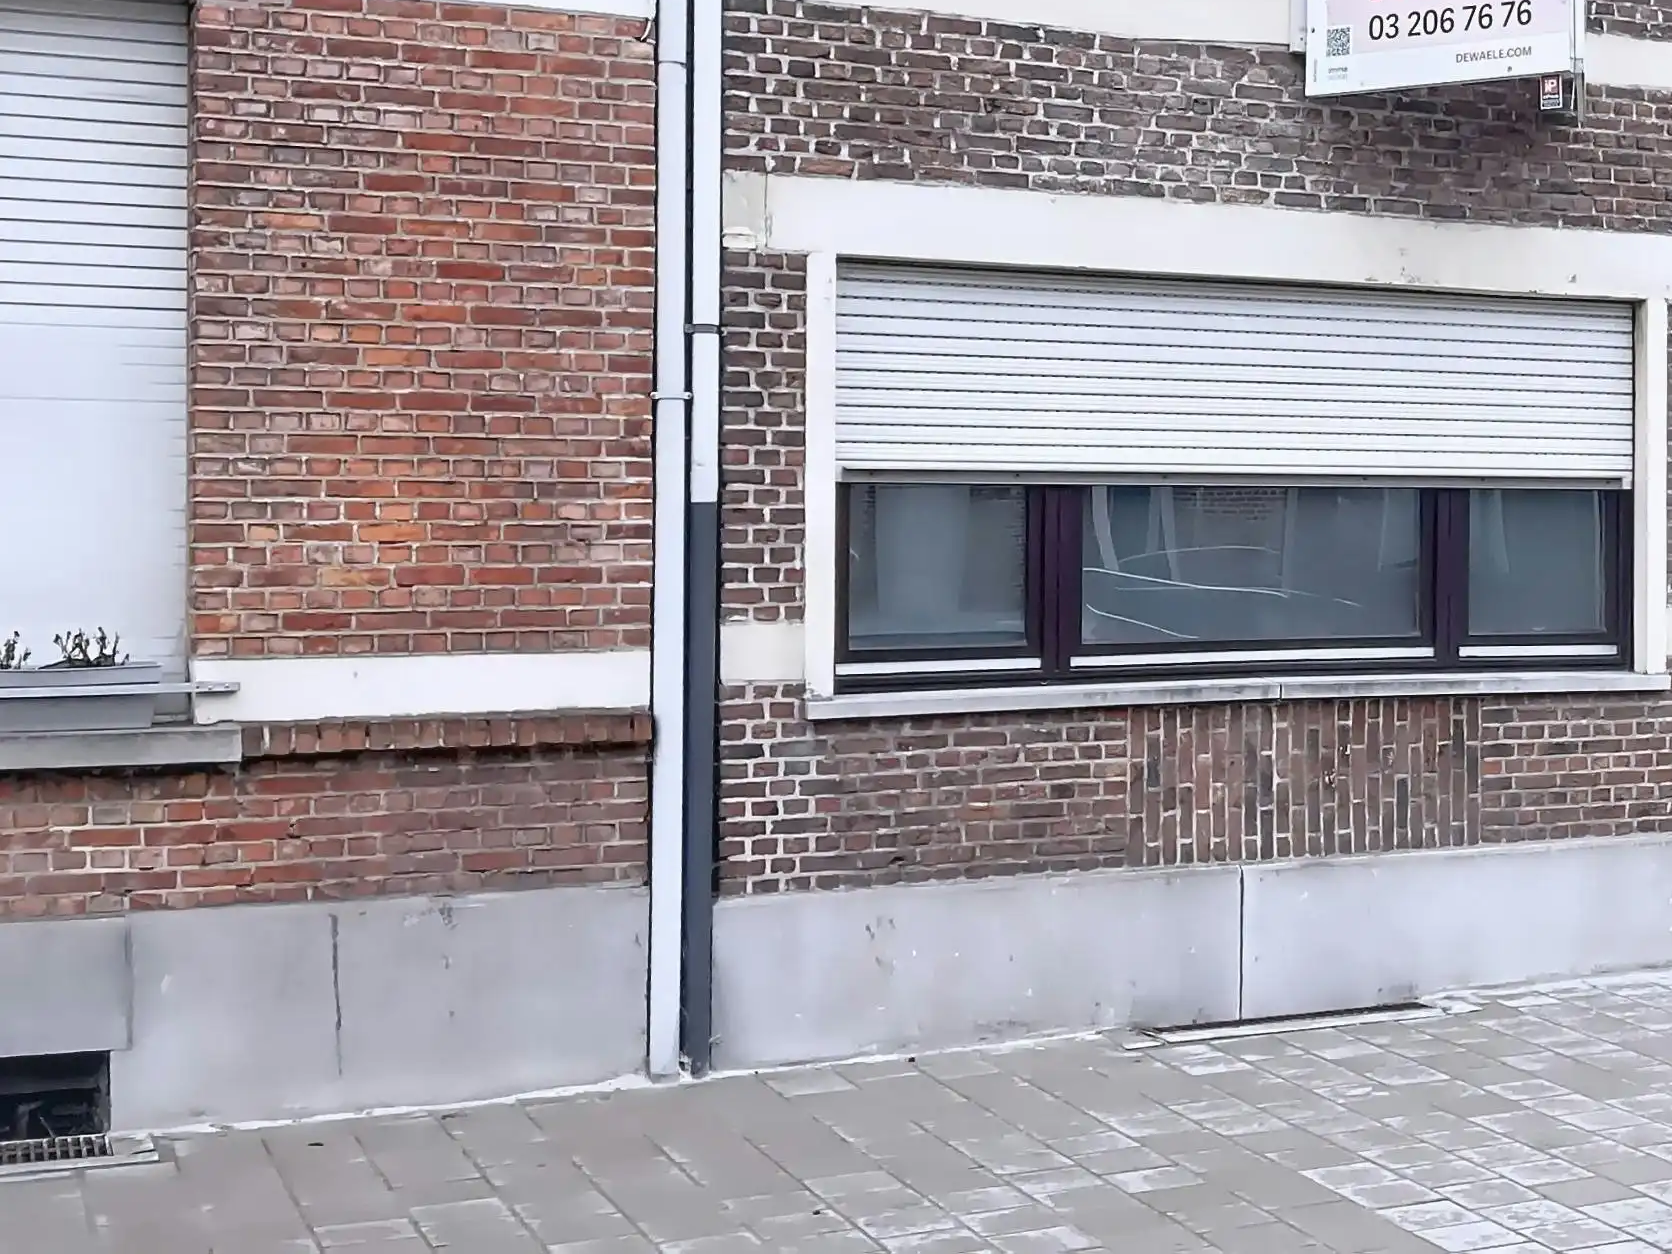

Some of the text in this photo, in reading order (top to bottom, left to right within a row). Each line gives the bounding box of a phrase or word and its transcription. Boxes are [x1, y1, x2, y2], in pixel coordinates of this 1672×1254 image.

[1368, 0, 1532, 41] 03 206 76 76
[1455, 46, 1532, 63] DEWAELE.COM
